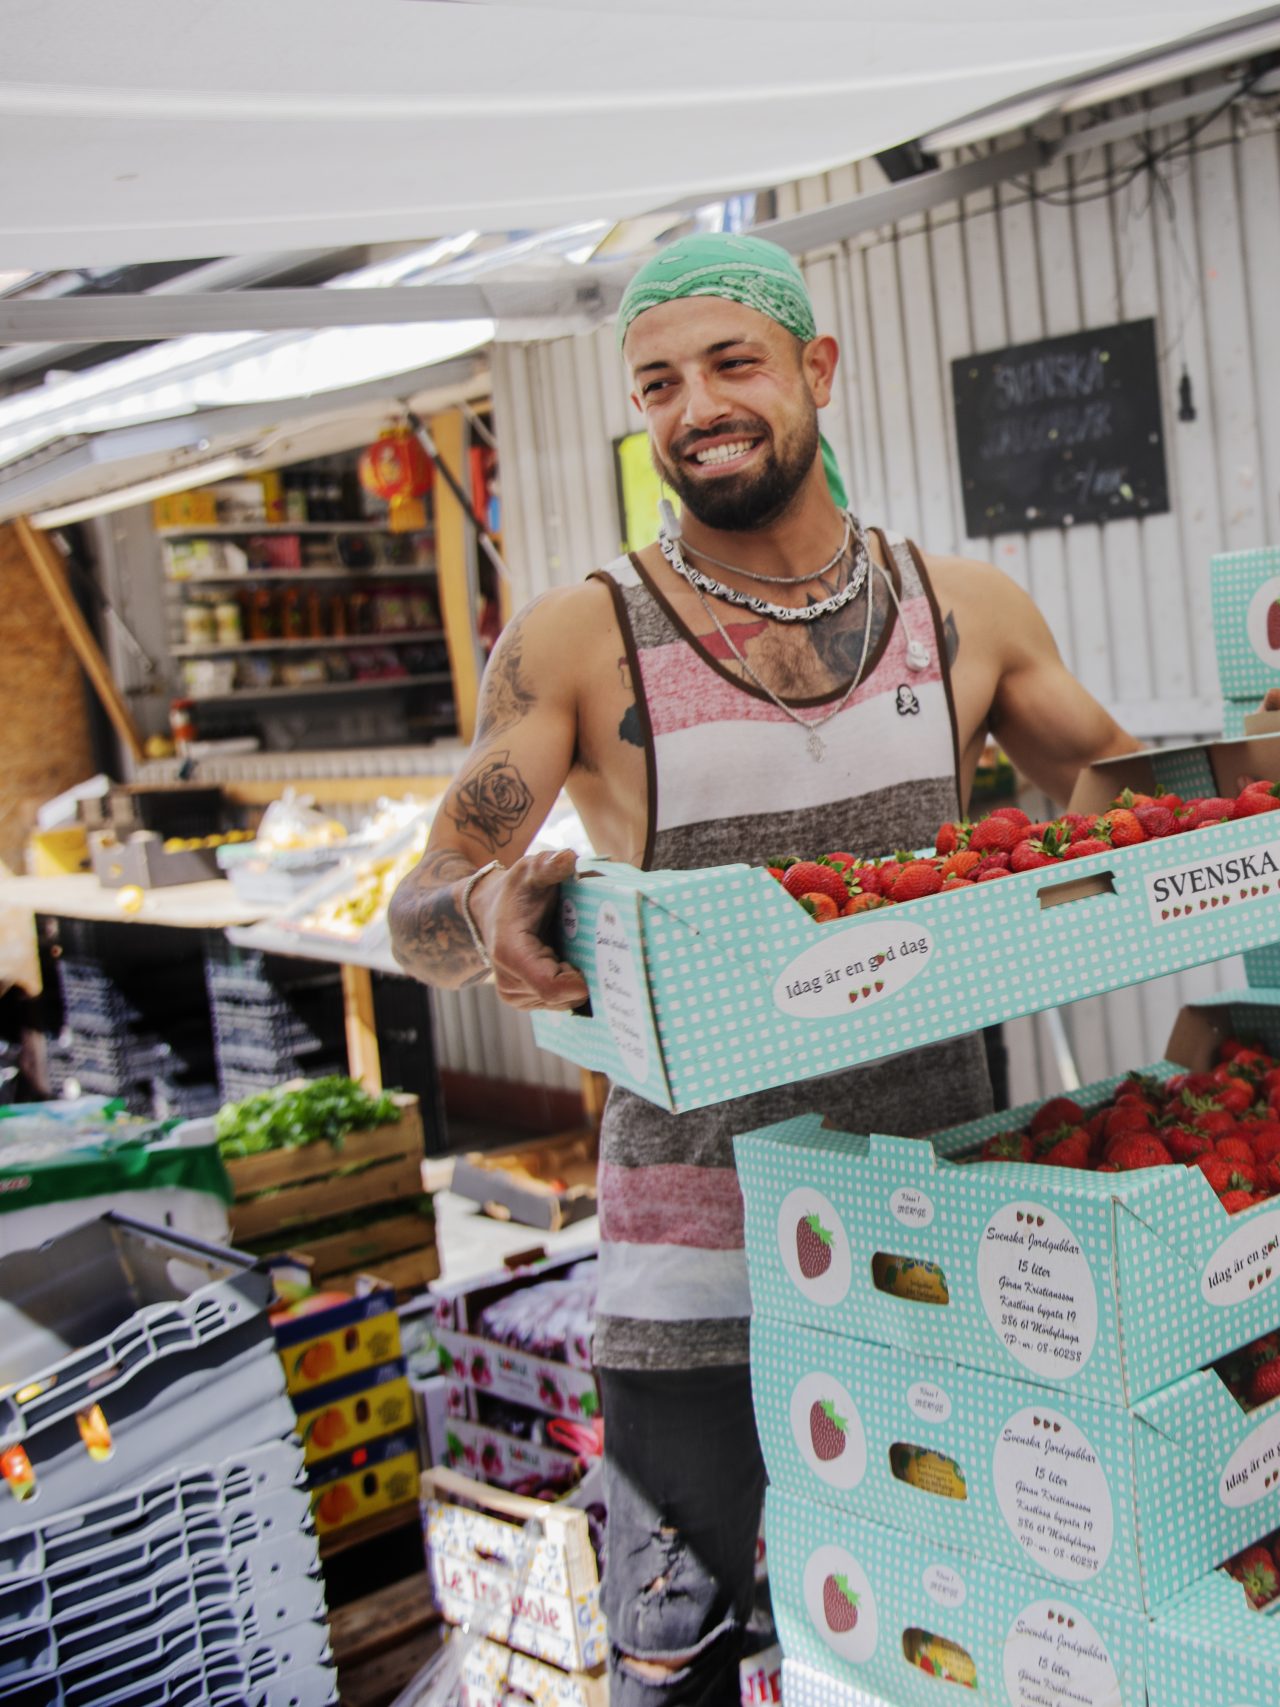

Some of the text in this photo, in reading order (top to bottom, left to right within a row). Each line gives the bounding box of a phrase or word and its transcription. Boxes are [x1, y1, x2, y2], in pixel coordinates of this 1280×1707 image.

[1153, 851, 1279, 903] SVENSKA
[785, 976, 823, 999] Idag
[824, 969, 841, 985] är
[846, 961, 864, 976] en
[900, 937, 928, 956] dag
[987, 1227, 1080, 1255] Svenska Jordgubbar
[1018, 1260, 1051, 1278] 15 liter
[1208, 1267, 1232, 1289] Idag
[1234, 1259, 1243, 1273] är
[1247, 1250, 1259, 1265] en
[999, 1276, 1074, 1302] Göran Kristiansson
[1021, 1319, 1028, 1329] 61
[1038, 1305, 1062, 1320] bygata
[1067, 1312, 1076, 1322] 19
[1003, 1429, 1096, 1464] Svenska Jordgubbar
[1035, 1466, 1068, 1487] 15 liter
[1226, 1468, 1248, 1491] Idag
[1250, 1459, 1259, 1473] är
[1263, 1448, 1274, 1463] en
[1016, 1480, 1091, 1512] Göran Kristiansson
[1037, 1525, 1045, 1534] 61
[1083, 1521, 1093, 1531] 19
[440, 1558, 463, 1595] Le
[1016, 1620, 1108, 1663] Svenska Jordgubbar
[1038, 1656, 1070, 1678] 15 liter
